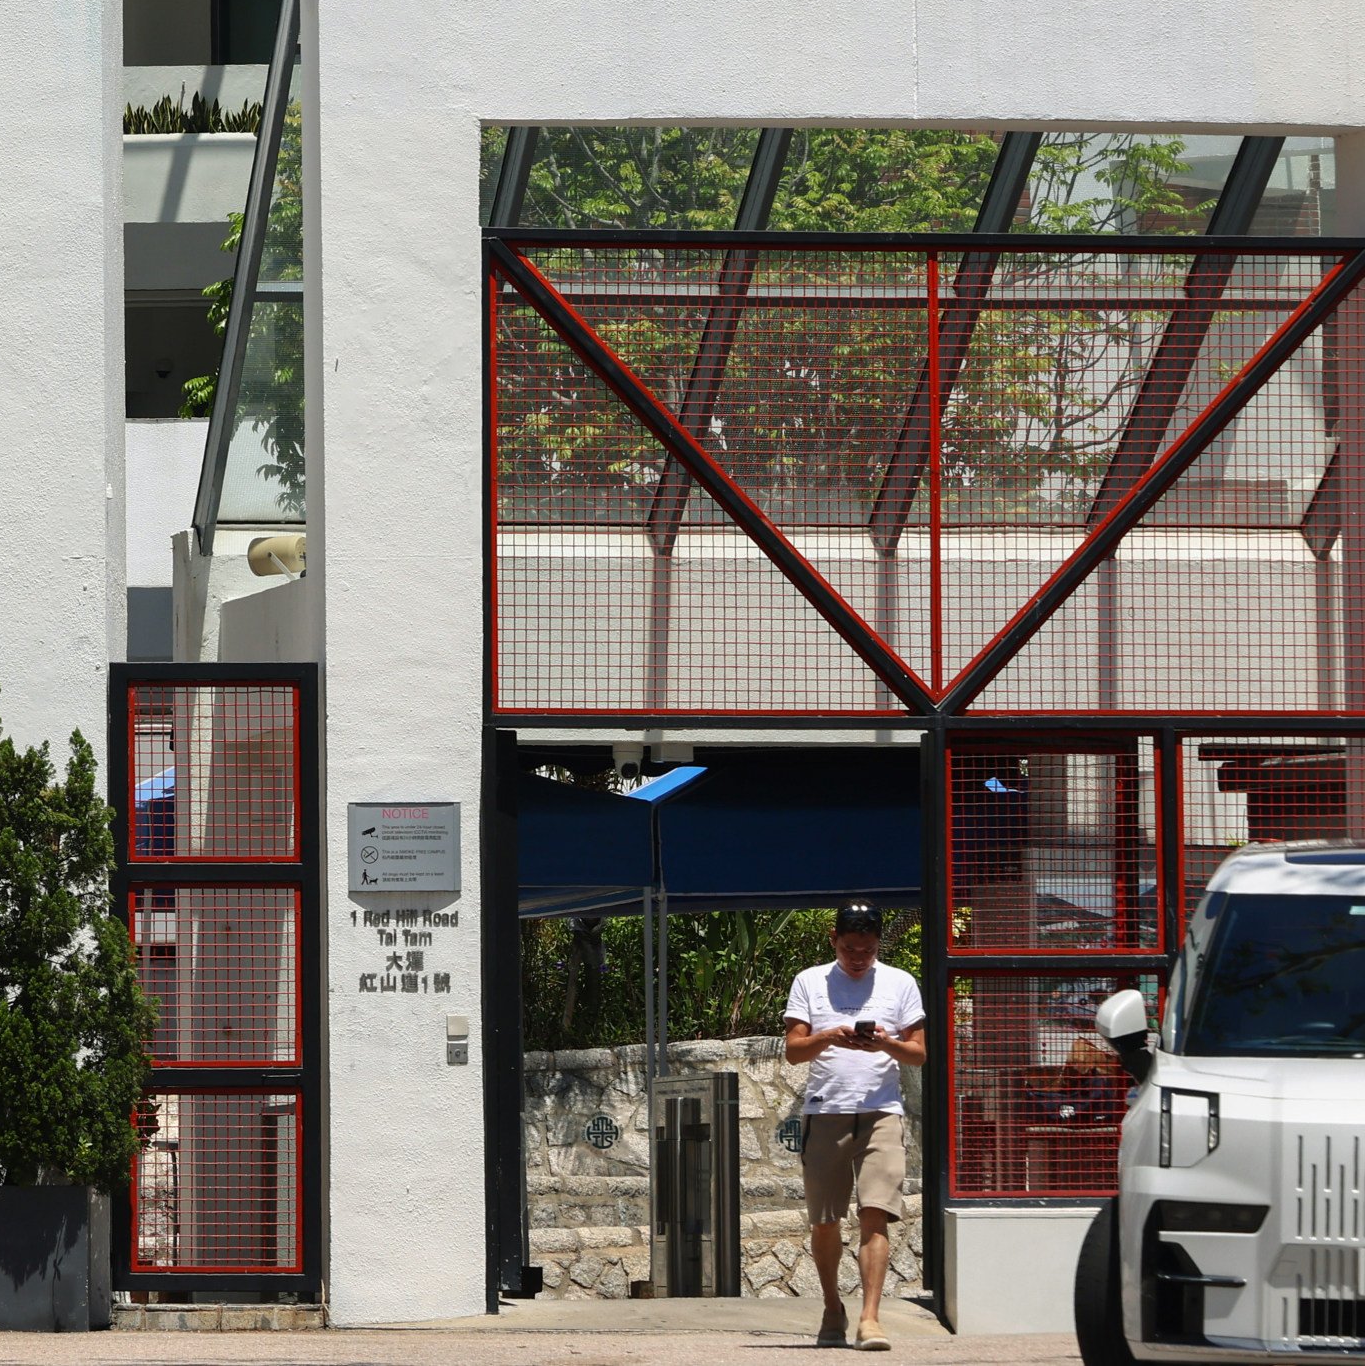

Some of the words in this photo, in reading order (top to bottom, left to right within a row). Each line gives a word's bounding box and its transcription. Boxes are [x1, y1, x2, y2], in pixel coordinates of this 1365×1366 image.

[382, 808, 429, 819] NOTICE
[350, 910, 357, 927] 1
[364, 910, 390, 927] Red
[396, 909, 418, 927] Hill
[422, 909, 459, 927] Road
[377, 929, 397, 946] Tai
[402, 929, 432, 946] Tam
[386, 951, 424, 972] 大潭
